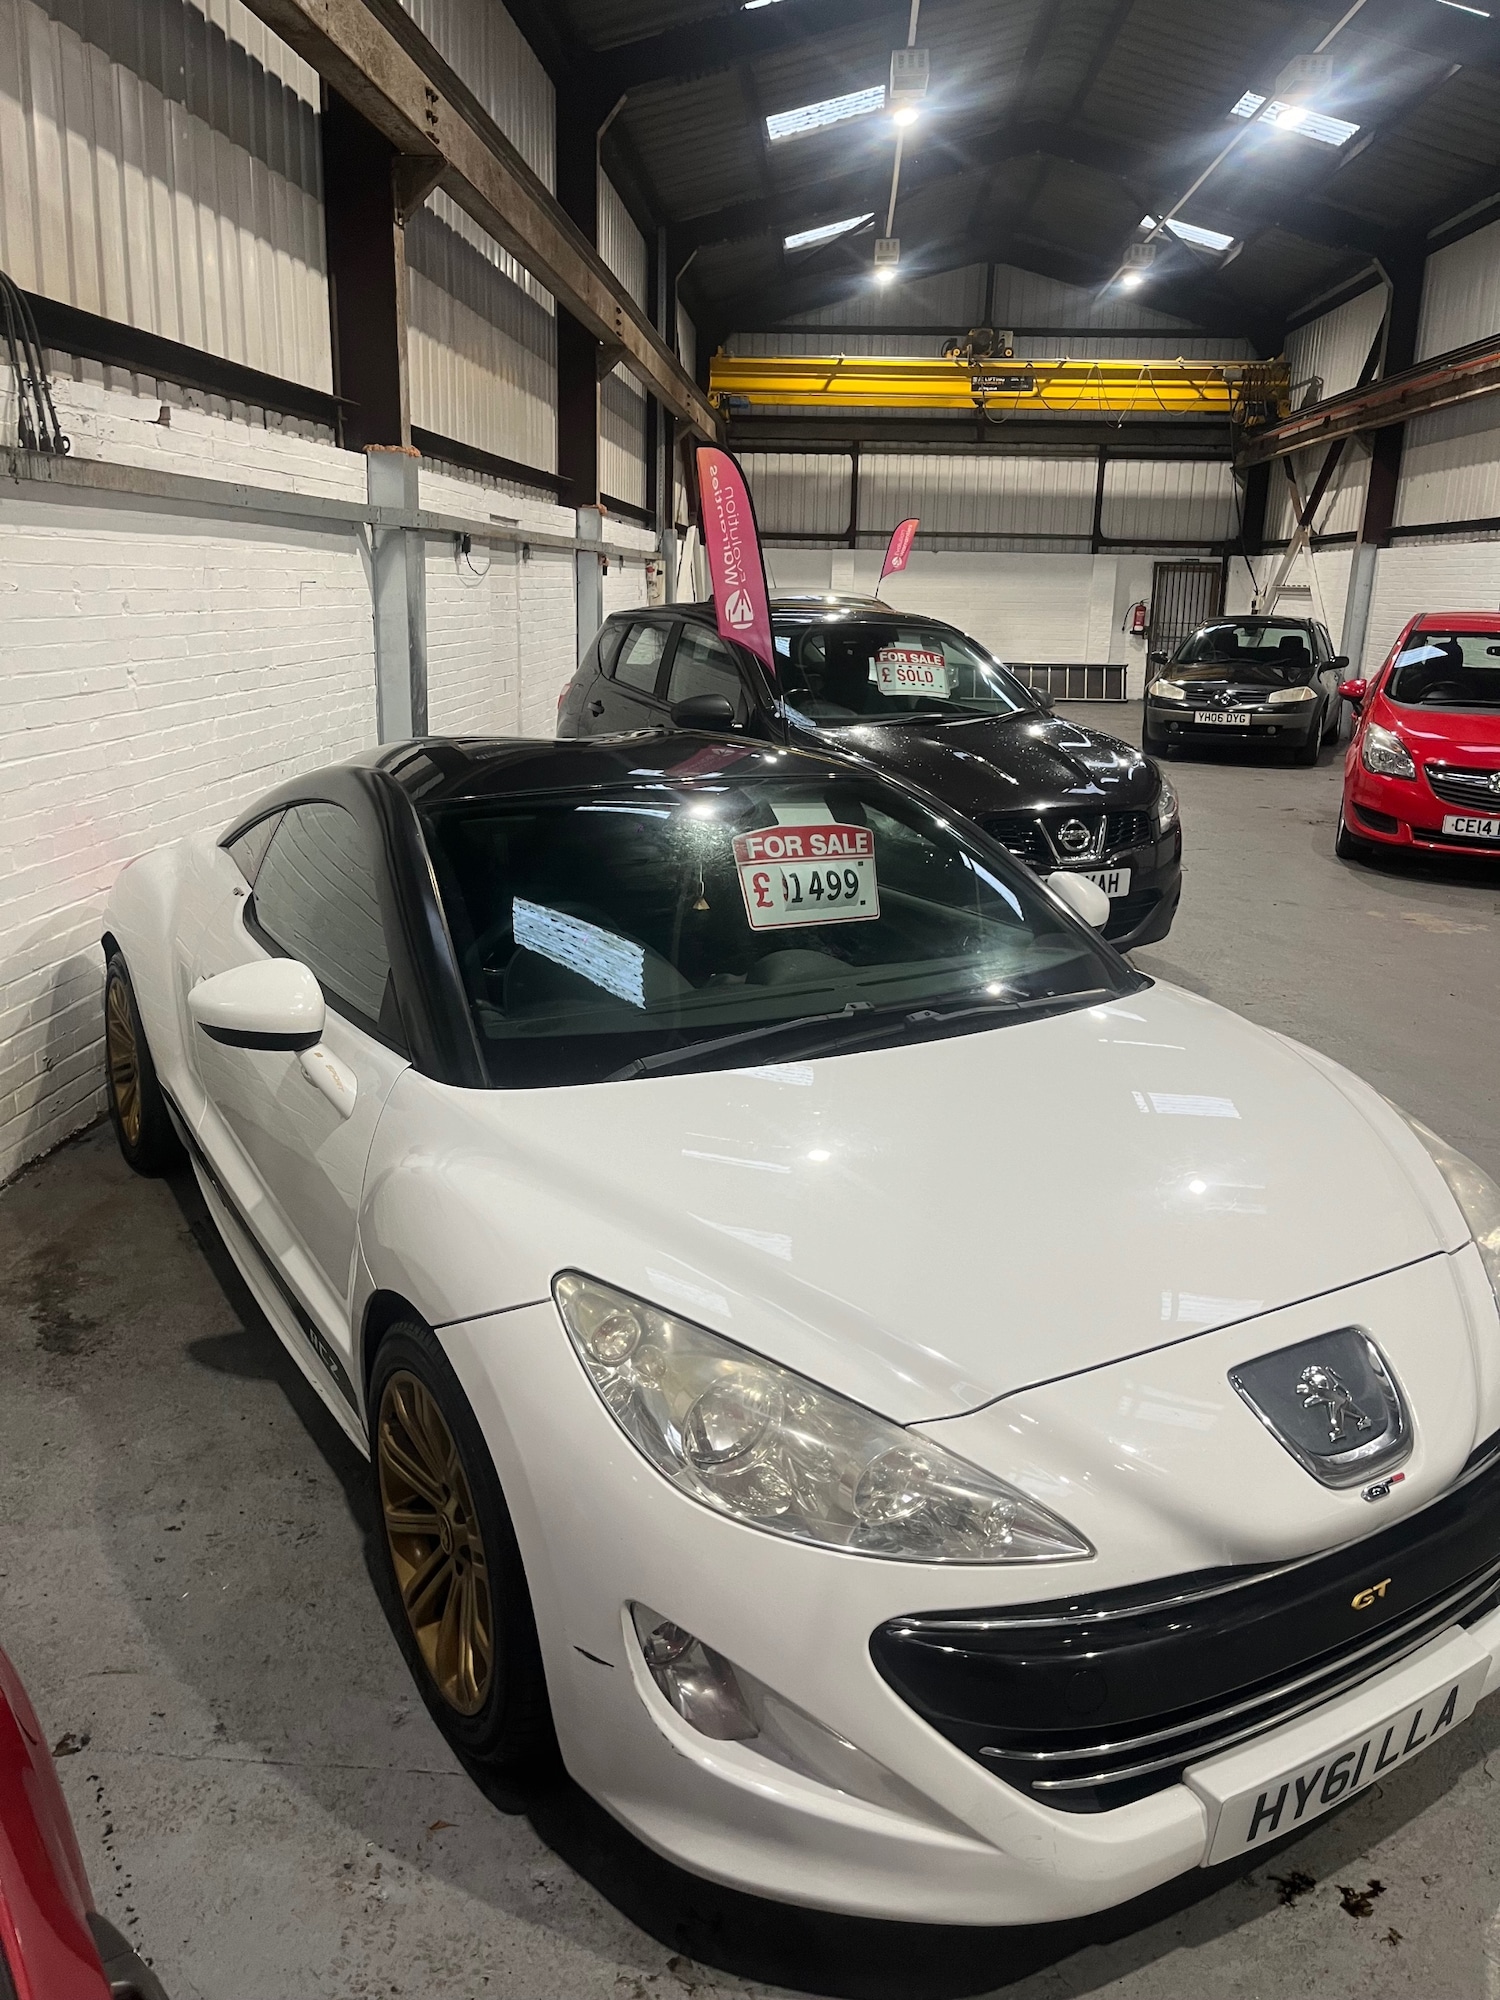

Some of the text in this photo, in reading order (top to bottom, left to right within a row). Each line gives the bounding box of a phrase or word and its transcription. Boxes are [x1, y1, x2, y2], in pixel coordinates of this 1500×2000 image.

[880, 651, 942, 666] FOR SALE
[896, 668, 934, 683] SOLD
[1198, 712, 1246, 723] YH06 DYG
[1454, 818, 1492, 835] CE14
[745, 832, 868, 860] FOR SALE
[1350, 1578, 1392, 1611] GT
[1246, 1684, 1459, 1843] HY61 LLA
